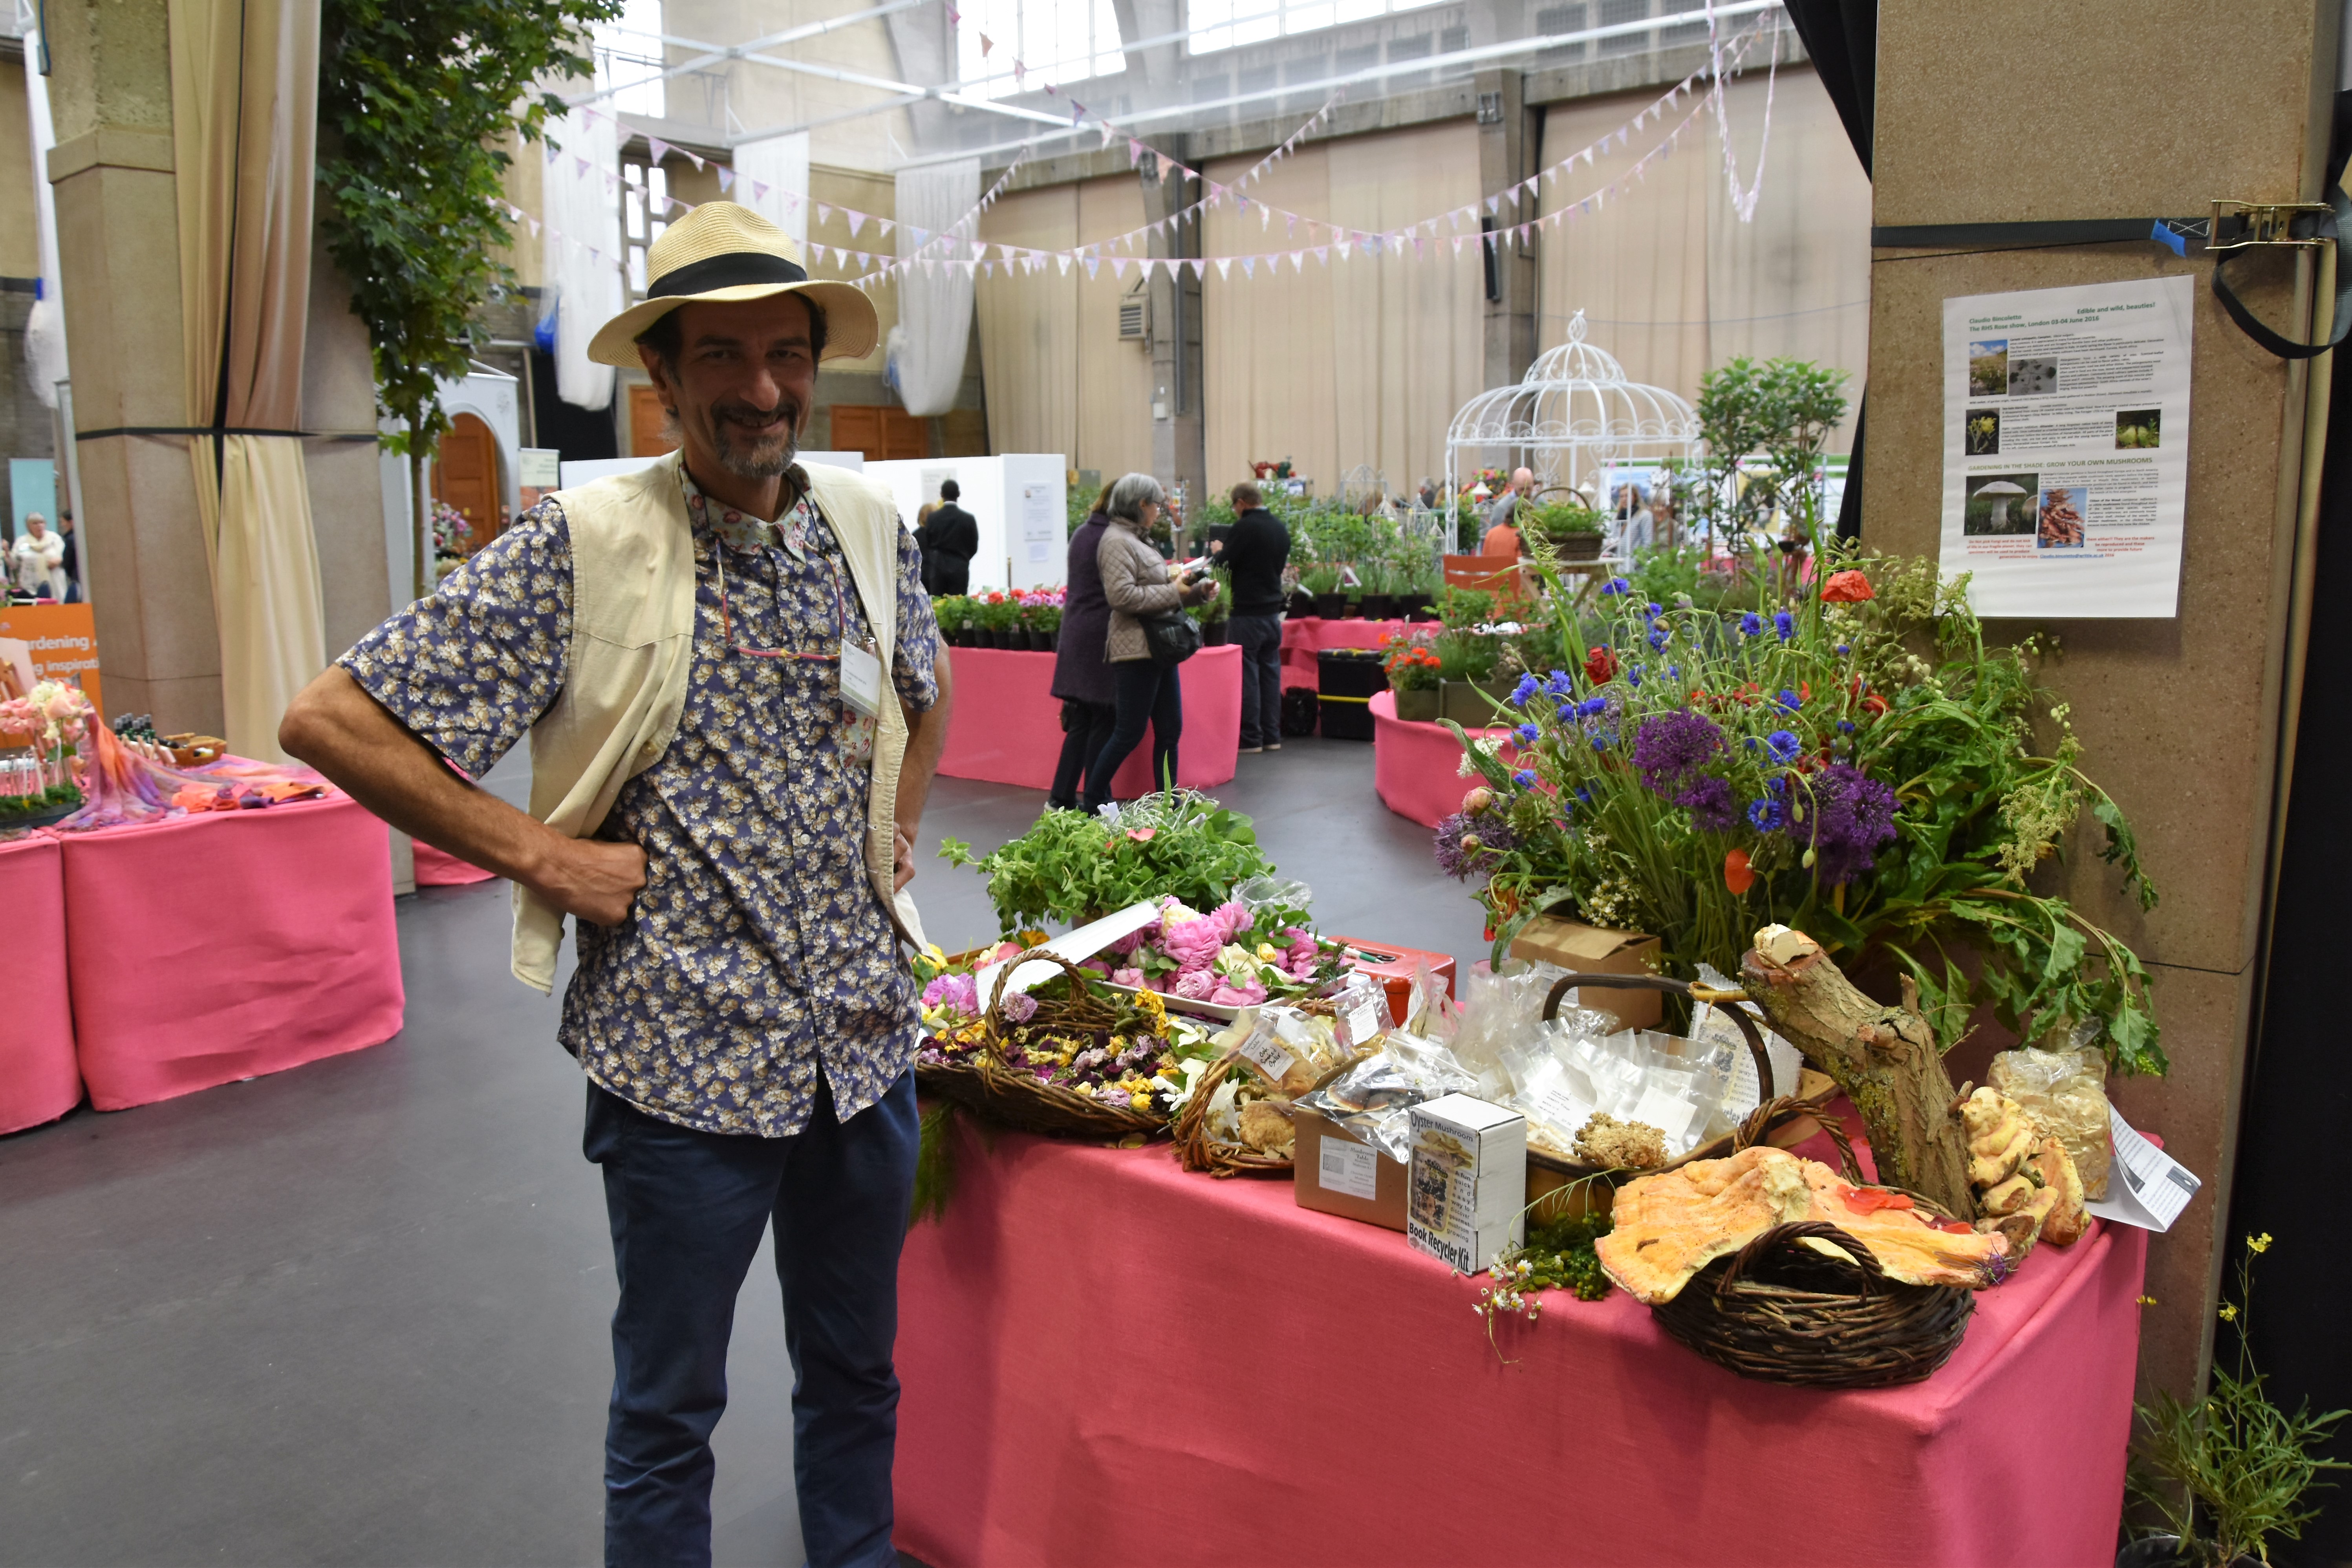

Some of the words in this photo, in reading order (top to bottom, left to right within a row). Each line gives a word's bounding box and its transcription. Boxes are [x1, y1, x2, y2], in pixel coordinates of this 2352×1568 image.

[1242, 1033, 1260, 1053] Mushroom
[1250, 1040, 1260, 1050] Table
[1259, 1047, 1269, 1057] Oak
[1730, 1096, 1755, 1106] growing
[1411, 1111, 1433, 1132] Oyster
[1435, 1122, 1473, 1142] Mushroom
[1350, 1147, 1375, 1157] Mushroom
[1461, 1172, 1471, 1181] fun
[1454, 1178, 1471, 1189] quick
[1452, 1193, 1470, 1204] easy
[1451, 1200, 1463, 1209] way
[1450, 1207, 1470, 1218] discover
[1449, 1214, 1470, 1227] gourmet
[1448, 1221, 1469, 1234] mushroom
[1447, 1228, 1469, 1243] growing
[1409, 1222, 1427, 1243] Book
[1428, 1231, 1457, 1264] Recycler
[1458, 1247, 1469, 1272] Kit
